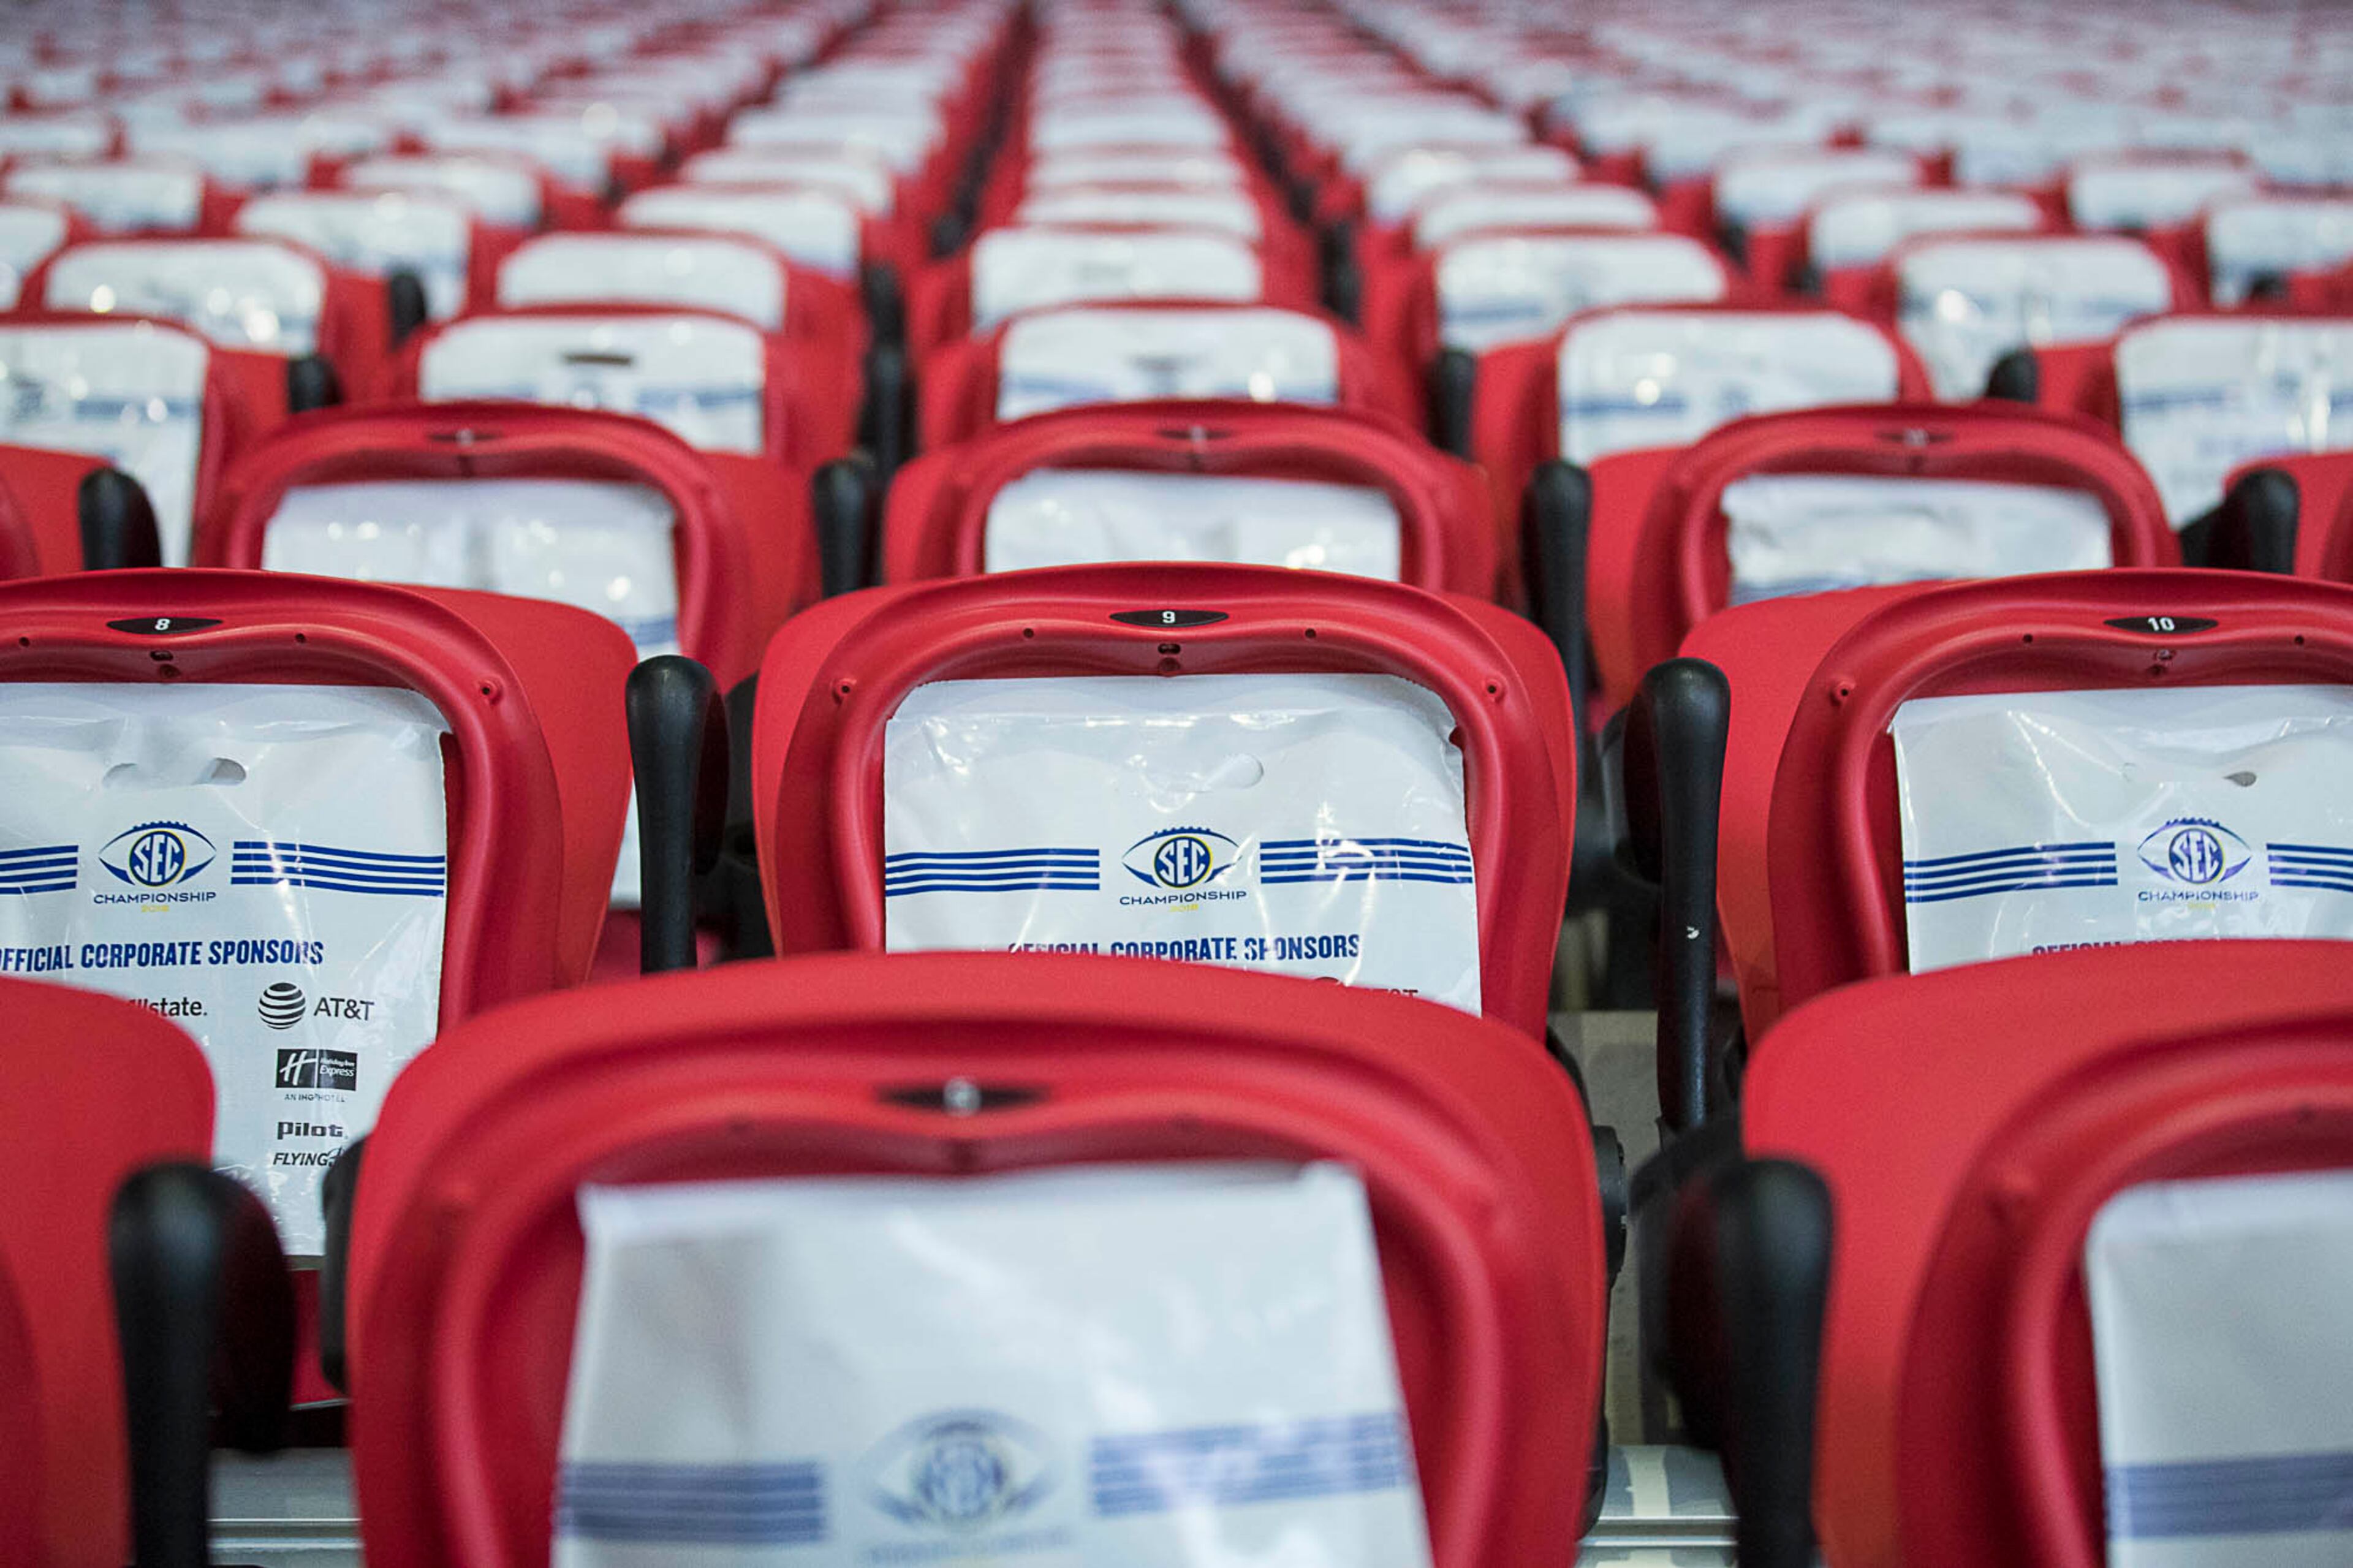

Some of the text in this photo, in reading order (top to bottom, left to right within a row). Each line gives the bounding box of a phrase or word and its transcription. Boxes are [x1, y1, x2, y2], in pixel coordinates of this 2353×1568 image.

[155, 618, 171, 631] 8
[1162, 610, 1176, 624] 9
[2147, 617, 2175, 632] 10
[133, 833, 181, 882] SEC
[1158, 839, 1206, 885] SEC
[2170, 831, 2219, 881] SEC
[93, 892, 216, 904] CHAMPIONSHIP
[1119, 890, 1247, 906] CHAMPIONSHIP
[2138, 890, 2259, 902] CHAMPIONSHIP
[81, 941, 203, 969] CORPORATE
[208, 939, 324, 966] SPONSORS
[1110, 937, 1237, 961] CORPORATE
[129, 997, 208, 1017] lstate.
[313, 997, 375, 1021] AT&T
[320, 1065, 355, 1077] Express
[273, 1153, 329, 1166] FLYING
